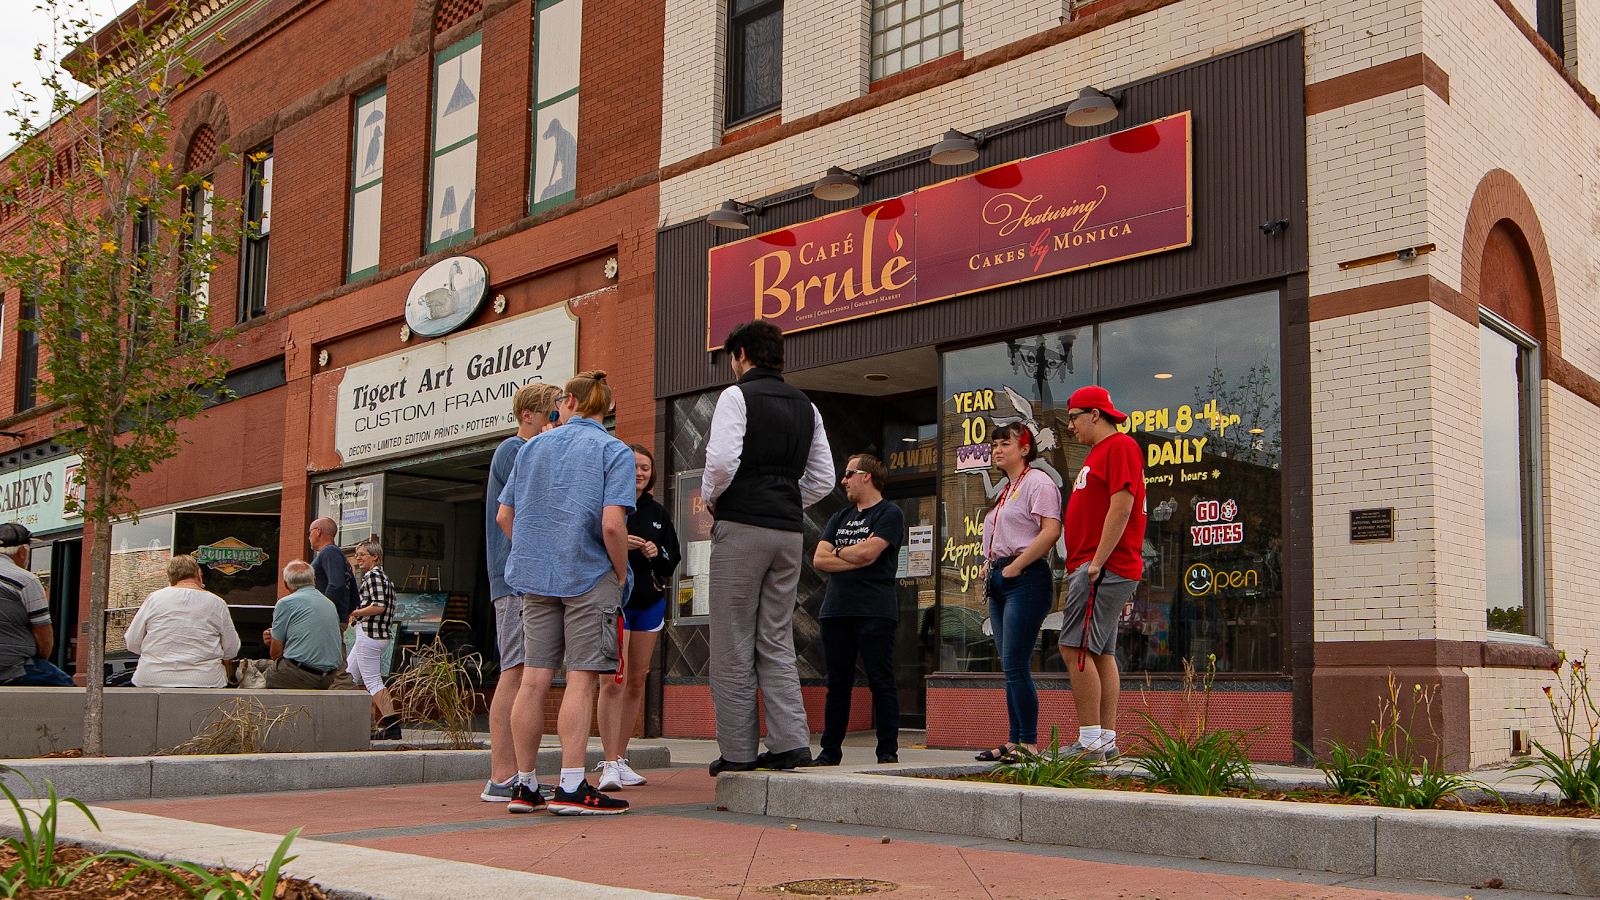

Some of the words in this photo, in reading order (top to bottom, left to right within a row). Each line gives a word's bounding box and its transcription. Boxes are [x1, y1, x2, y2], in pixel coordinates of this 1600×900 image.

[982, 185, 1107, 236] Featuring
[968, 248, 1026, 270] CAKES
[1030, 228, 1050, 273] by
[1053, 223, 1132, 252] MONICA
[353, 376, 407, 411] Tigert
[417, 363, 454, 394] Art
[466, 341, 552, 381] Gallery
[953, 389, 995, 414] YEAR
[354, 401, 435, 432] CUSTOM
[961, 416, 986, 446] 10
[1116, 407, 1169, 435] OPEN
[348, 442, 372, 457] DECOYS
[377, 436, 402, 451] LIMITED
[404, 430, 431, 445] EDITION
[433, 425, 459, 440] PRINTS
[465, 415, 500, 432] POTTERY
[890, 451, 905, 469] 24
[906, 449, 920, 468] W
[922, 447, 938, 465] Ma
[1148, 437, 1208, 467] DAILY
[0, 471, 53, 512] AREY'S
[1143, 473, 1173, 489] porary
[1181, 469, 1208, 483] hours
[964, 508, 984, 537] We
[1196, 500, 1219, 522] GO
[1190, 522, 1243, 546] YOTES
[200, 547, 260, 560] BOULEVARD
[899, 578, 915, 588] Open
